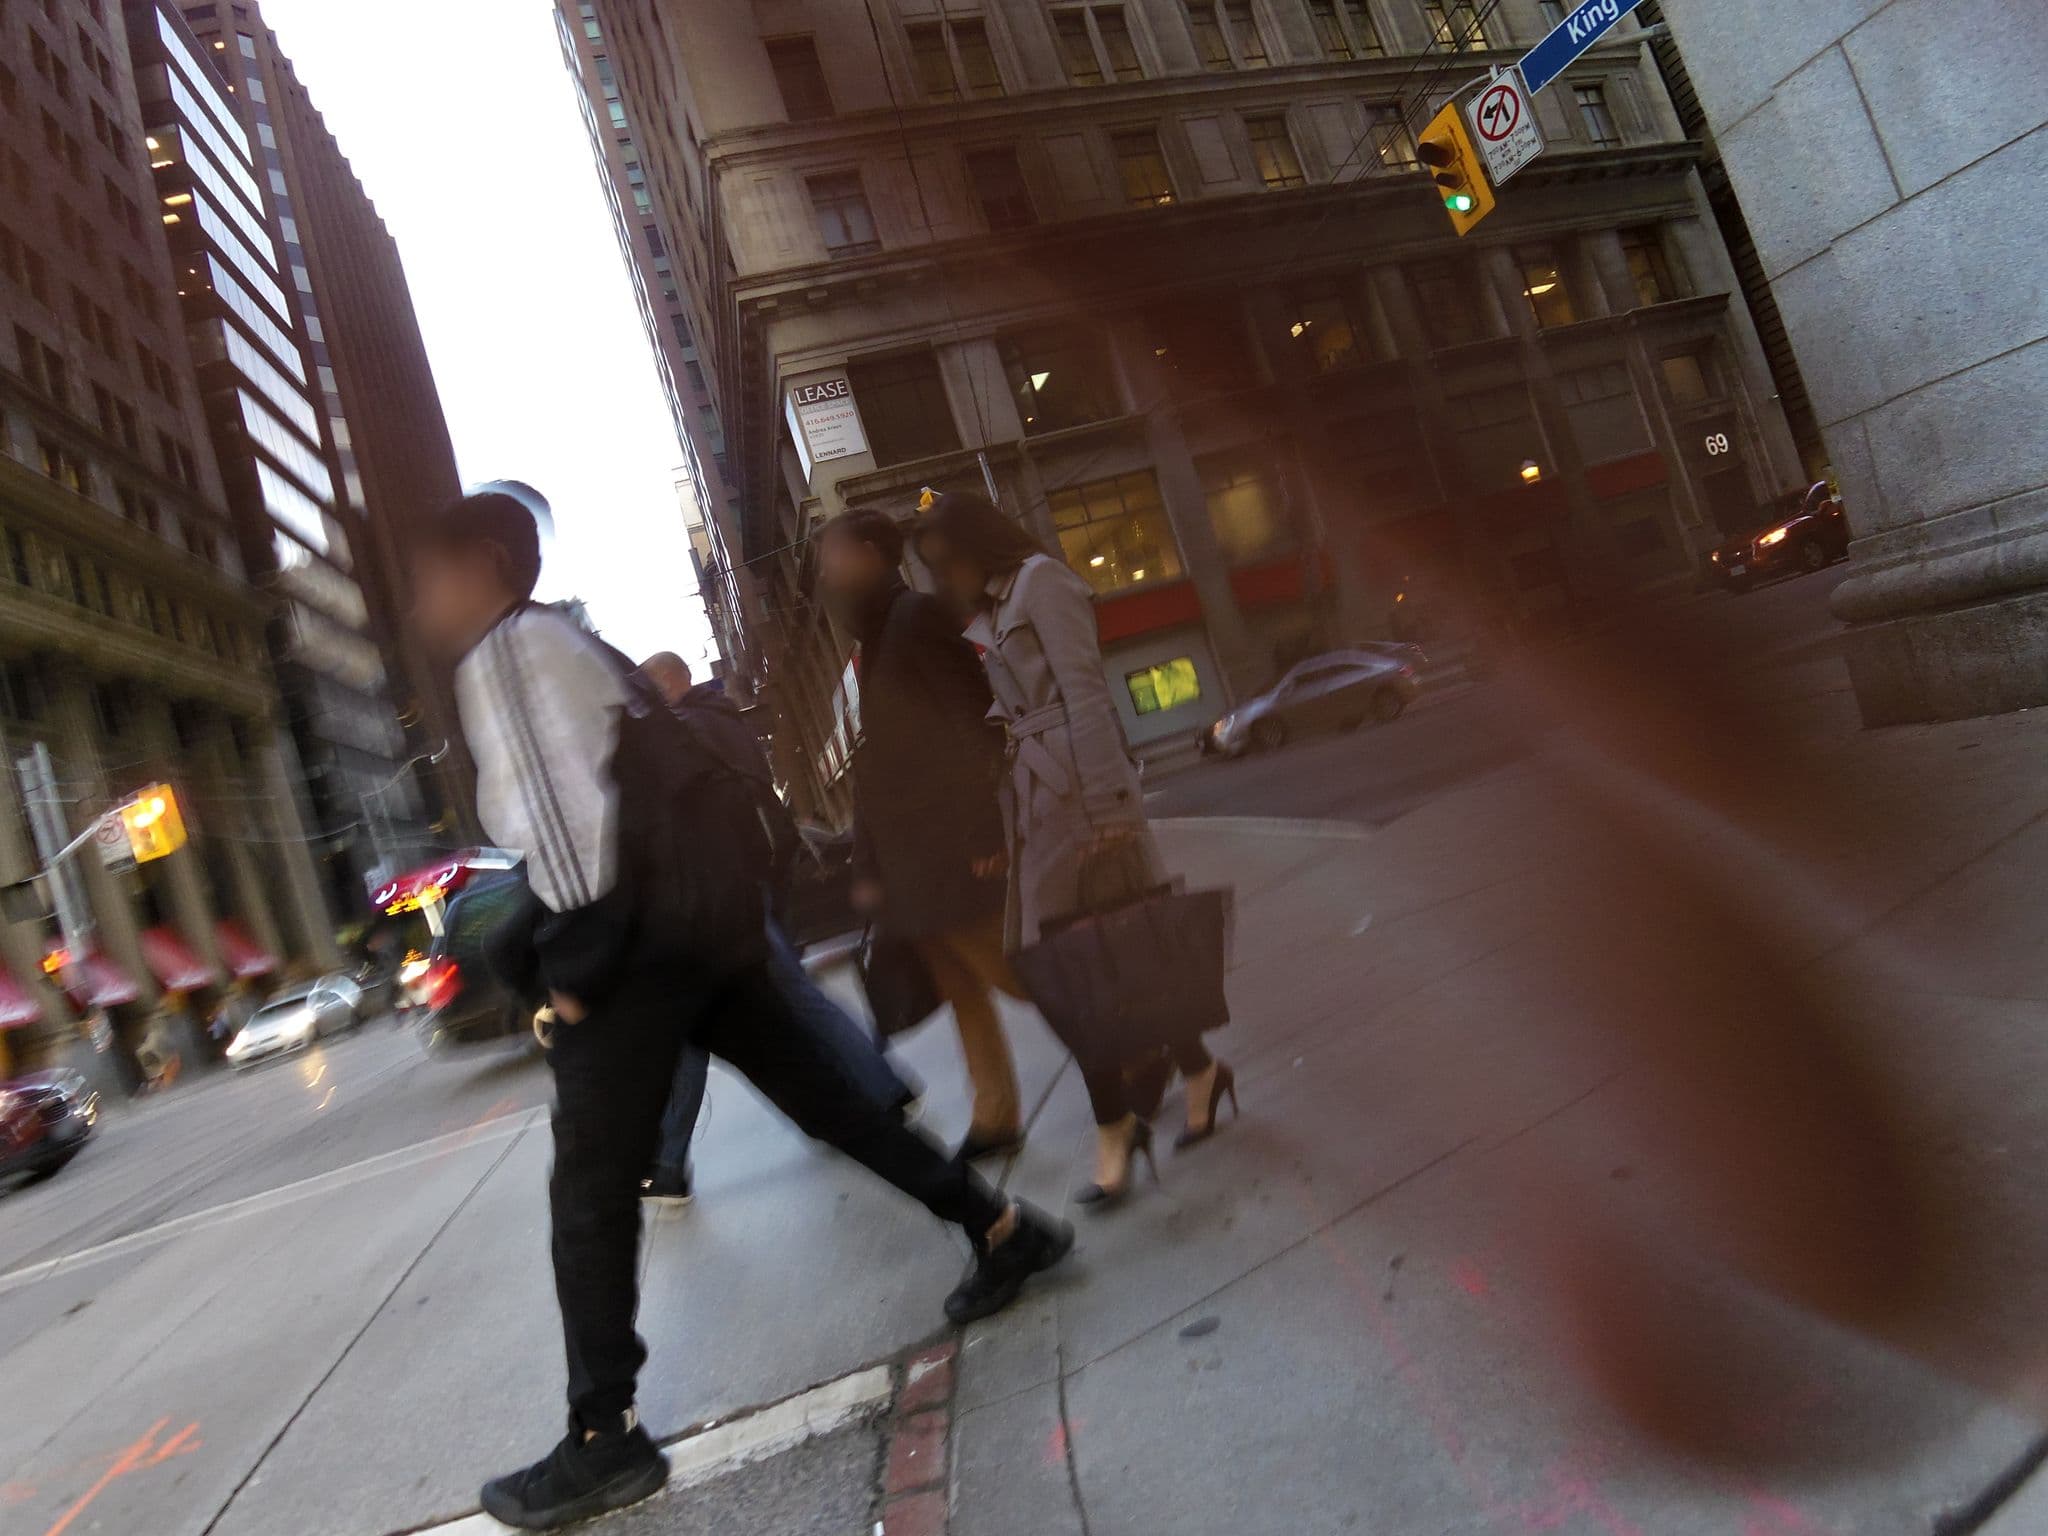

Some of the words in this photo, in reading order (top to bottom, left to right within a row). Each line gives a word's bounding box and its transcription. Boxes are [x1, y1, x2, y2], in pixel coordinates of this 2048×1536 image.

[1567, 0, 1619, 44] King
[795, 381, 847, 404] LEASE
[815, 447, 847, 459] LENNARD
[1705, 433, 1729, 456] 69
